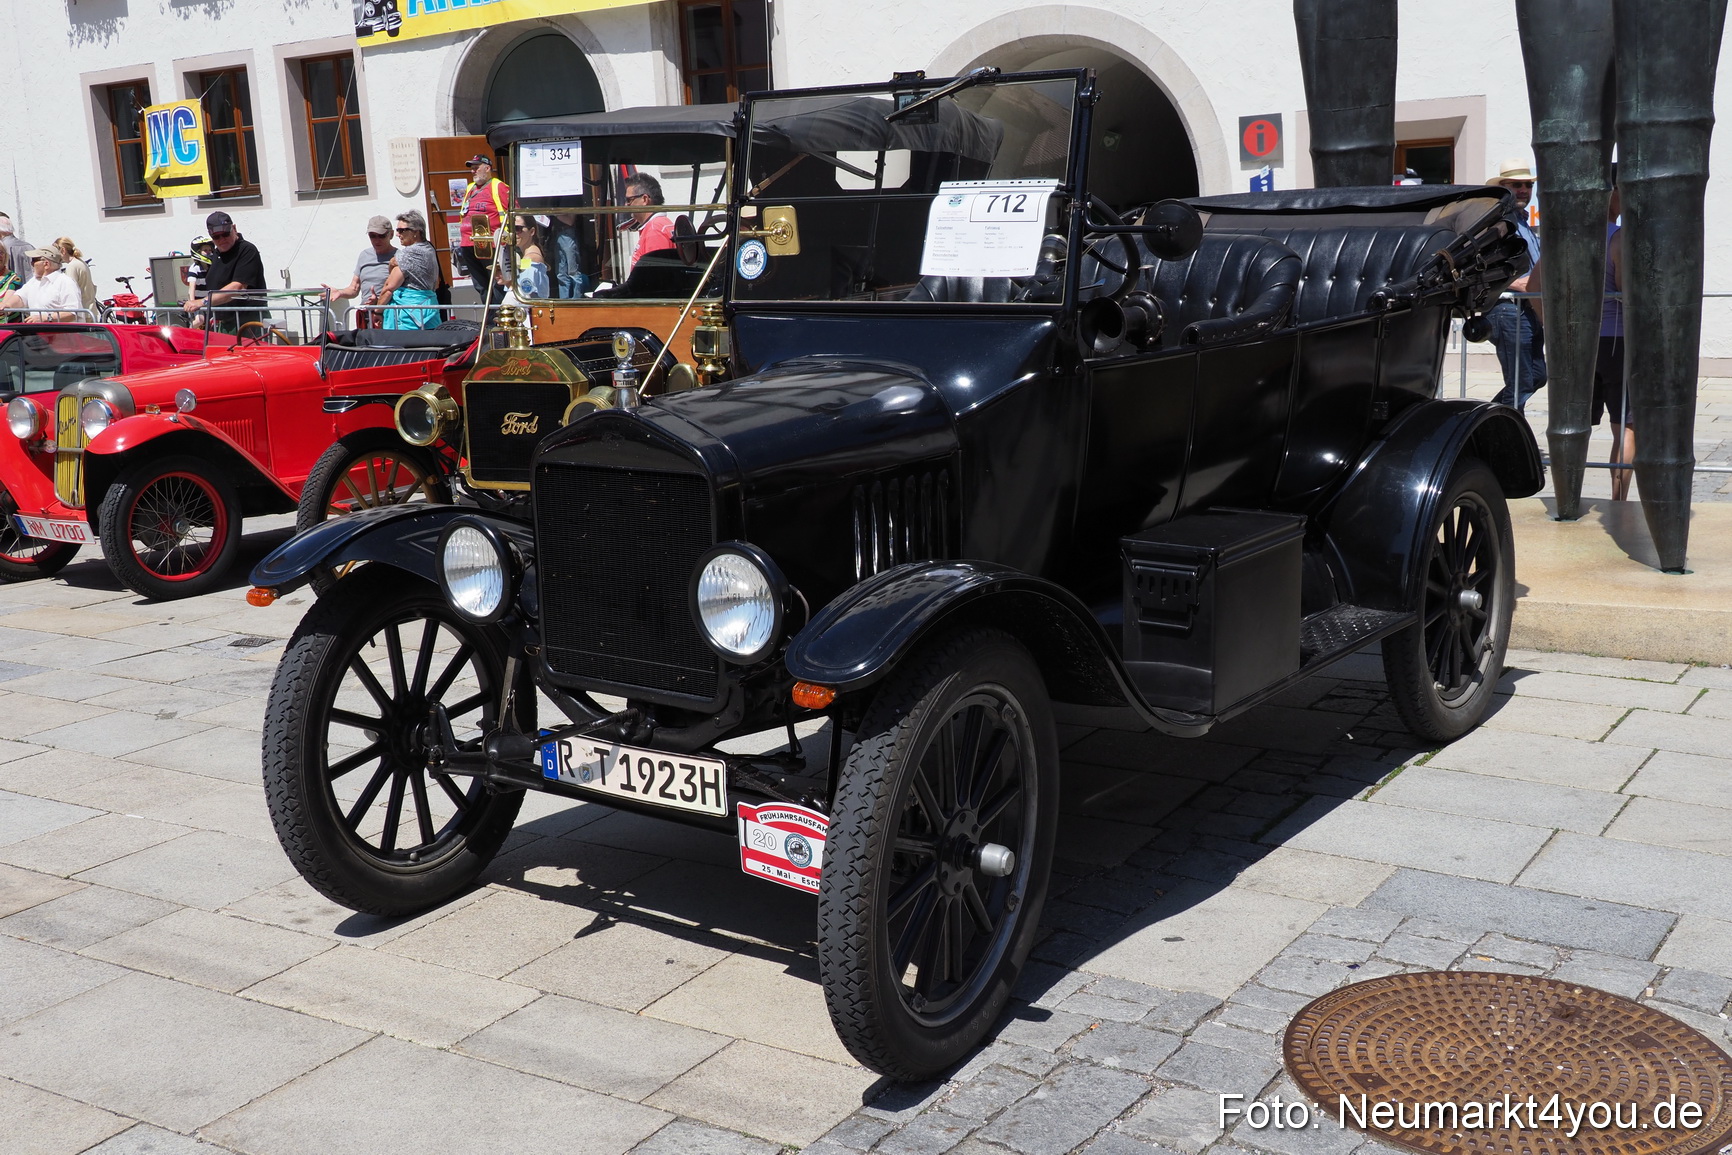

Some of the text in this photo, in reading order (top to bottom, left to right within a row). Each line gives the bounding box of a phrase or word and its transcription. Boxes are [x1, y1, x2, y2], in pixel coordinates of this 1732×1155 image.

[146, 106, 200, 169] WC
[549, 147, 571, 161] 334
[986, 193, 1028, 213] 712
[501, 356, 532, 377] Ford
[500, 411, 539, 435] Ford
[27, 520, 86, 541] NM 0700
[547, 759, 554, 770] D
[558, 740, 576, 778] R
[759, 811, 828, 835] FRÜHJAHRSAUSFAH
[752, 828, 778, 850] 20
[801, 876, 821, 888] Esch
